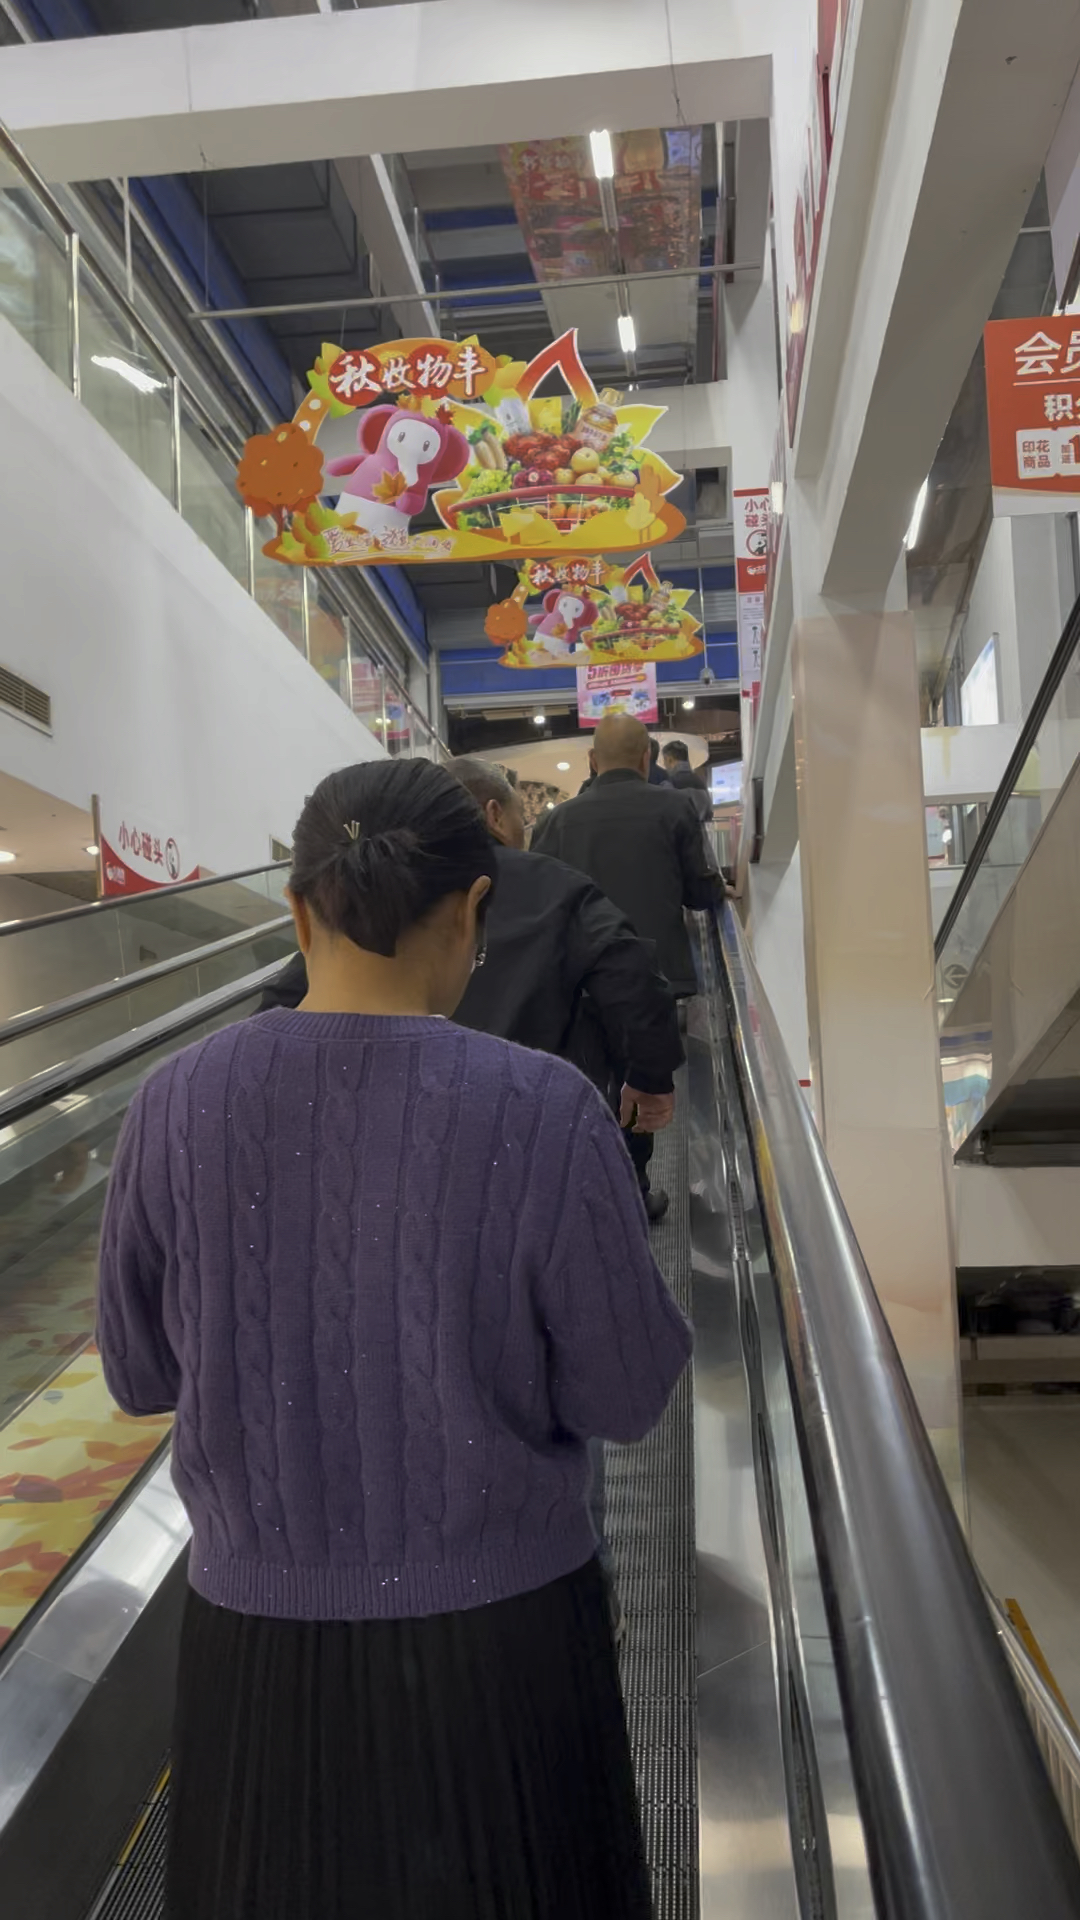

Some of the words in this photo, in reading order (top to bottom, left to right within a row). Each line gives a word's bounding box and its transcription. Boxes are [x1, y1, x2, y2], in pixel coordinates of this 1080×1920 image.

[329, 345, 487, 397] 秋收物丰
[1044, 394, 1080, 421] 积
[1022, 440, 1050, 453] 印花
